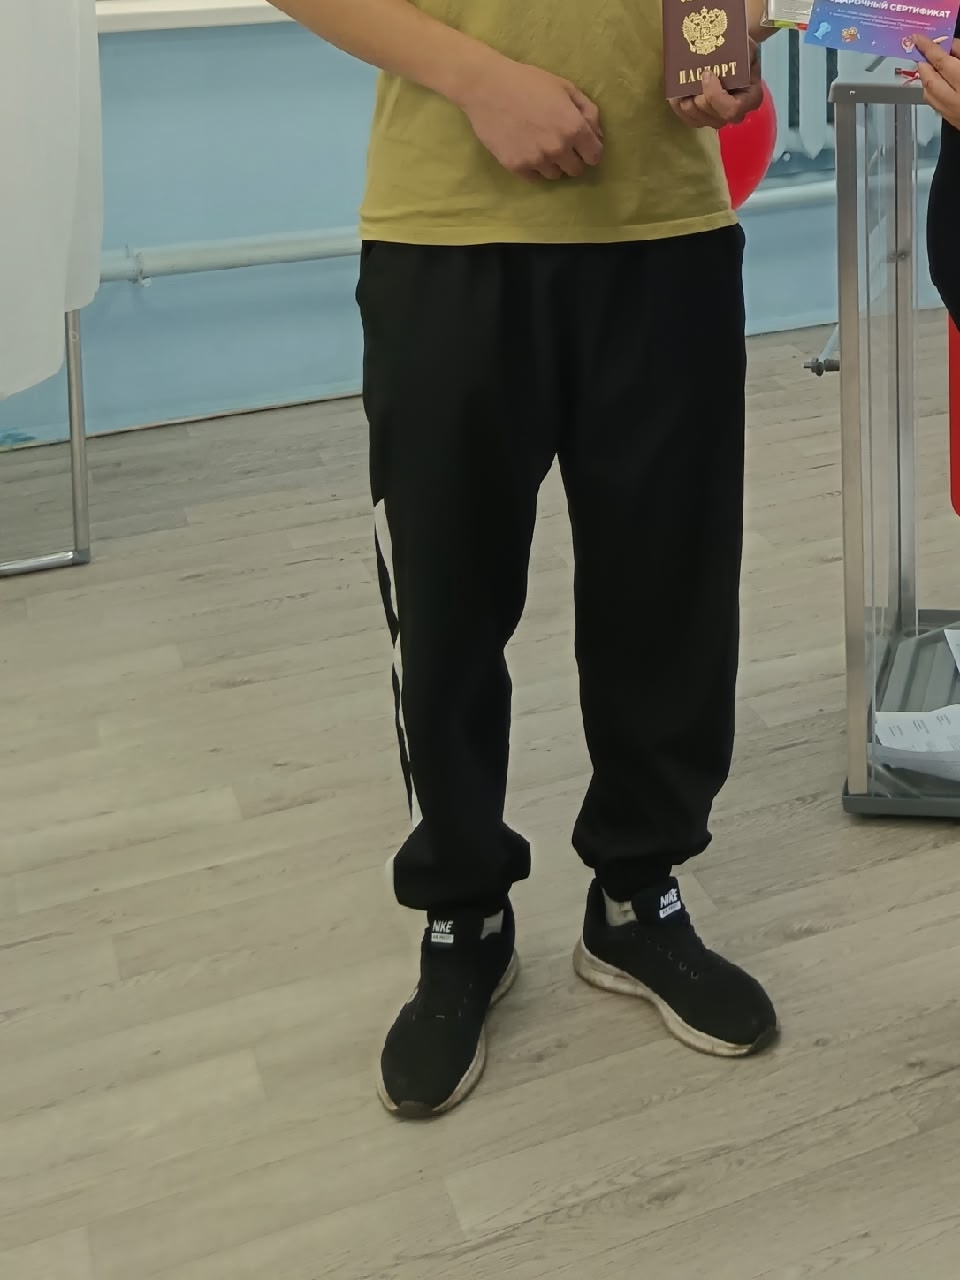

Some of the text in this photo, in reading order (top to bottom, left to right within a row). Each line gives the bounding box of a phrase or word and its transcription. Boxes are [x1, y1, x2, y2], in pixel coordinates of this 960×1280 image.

[889, 2, 951, 19] СЕРТИФИКАТ
[660, 888, 678, 908] NIKE
[432, 919, 454, 933] NIKE
